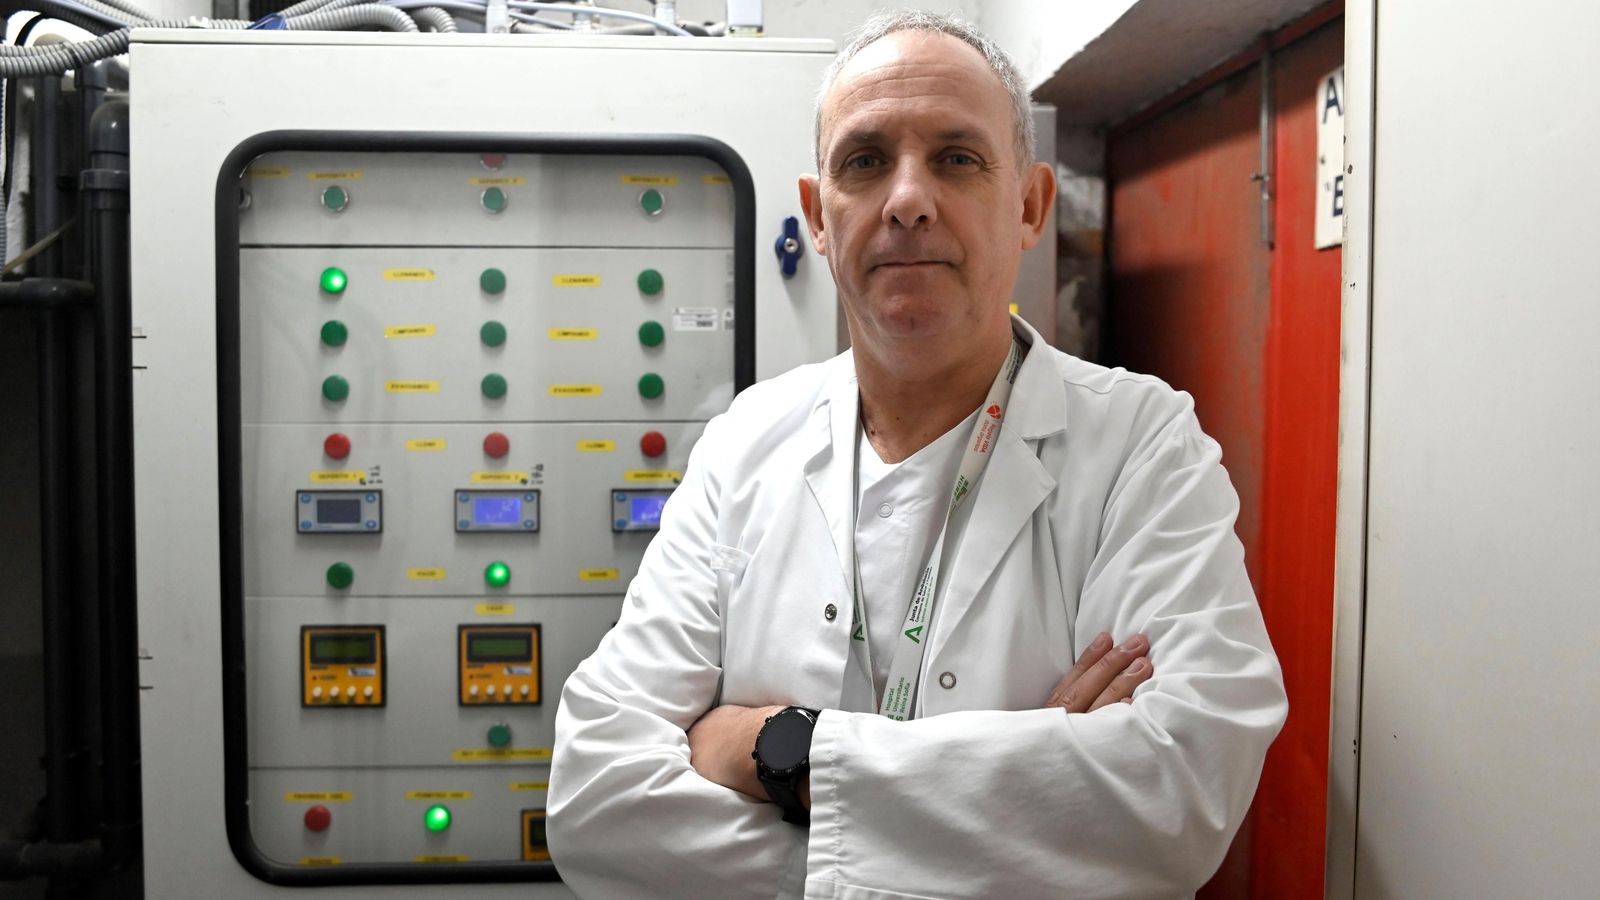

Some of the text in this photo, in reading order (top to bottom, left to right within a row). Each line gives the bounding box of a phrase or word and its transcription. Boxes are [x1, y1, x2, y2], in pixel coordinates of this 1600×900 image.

[1322, 77, 1344, 124] A
[910, 605, 918, 622] Junta
[886, 688, 895, 711] Hospital
[893, 677, 904, 712] Universitario
